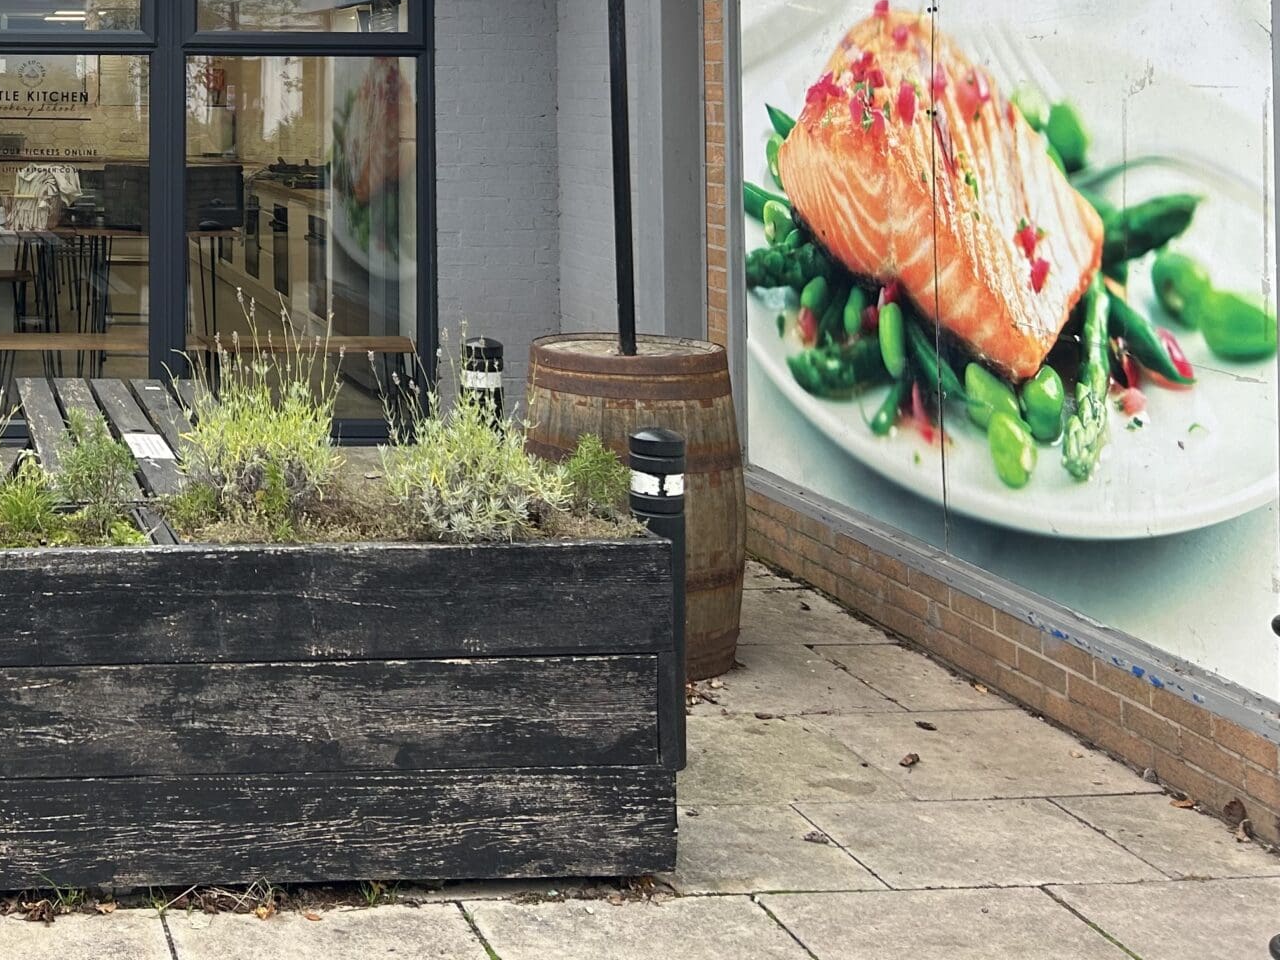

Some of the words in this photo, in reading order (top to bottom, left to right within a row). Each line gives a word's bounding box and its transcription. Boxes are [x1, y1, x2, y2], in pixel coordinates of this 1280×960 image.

[27, 91, 89, 103] KITCHEN
[25, 147, 60, 156] TICKETS
[64, 148, 98, 157] ONLINE
